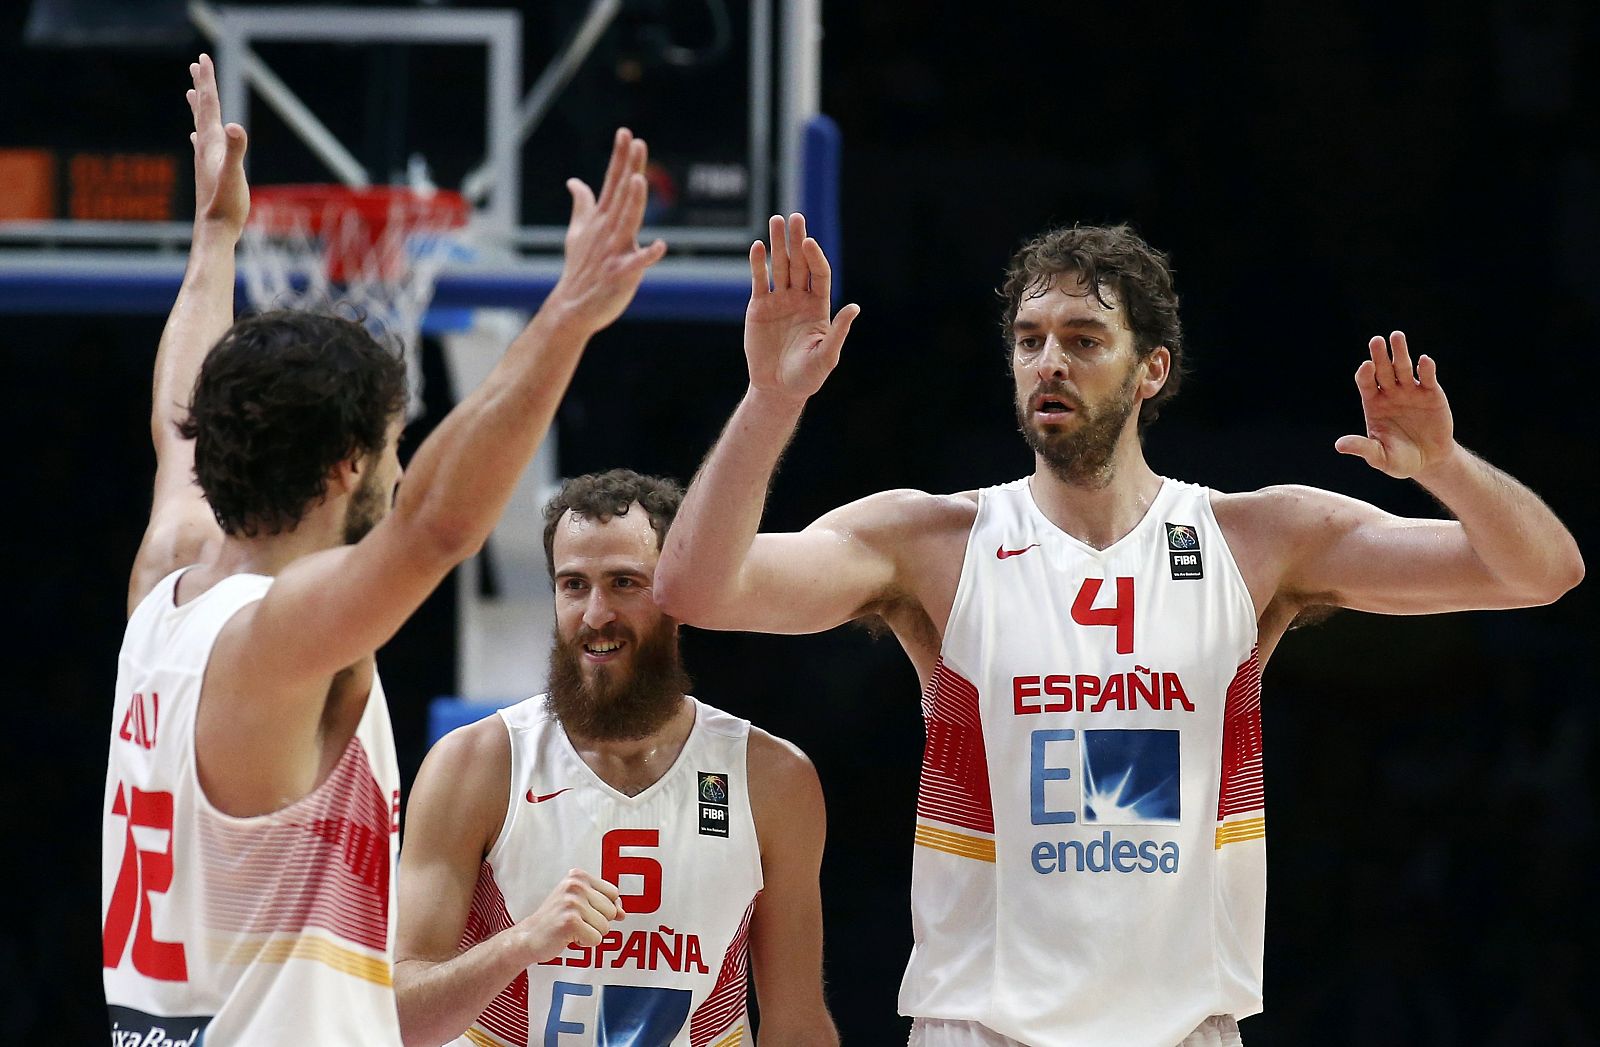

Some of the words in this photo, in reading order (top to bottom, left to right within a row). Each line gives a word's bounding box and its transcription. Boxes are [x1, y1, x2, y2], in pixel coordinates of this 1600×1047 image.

[1174, 555, 1198, 566] FIBA
[1071, 576, 1135, 654] 4
[1013, 665, 1196, 716] ESPAÑA
[1030, 729, 1076, 826] E
[703, 807, 725, 821] FIBA
[601, 828, 662, 914] 6
[1031, 831, 1181, 875] endesa
[538, 925, 710, 974] SPAÑA
